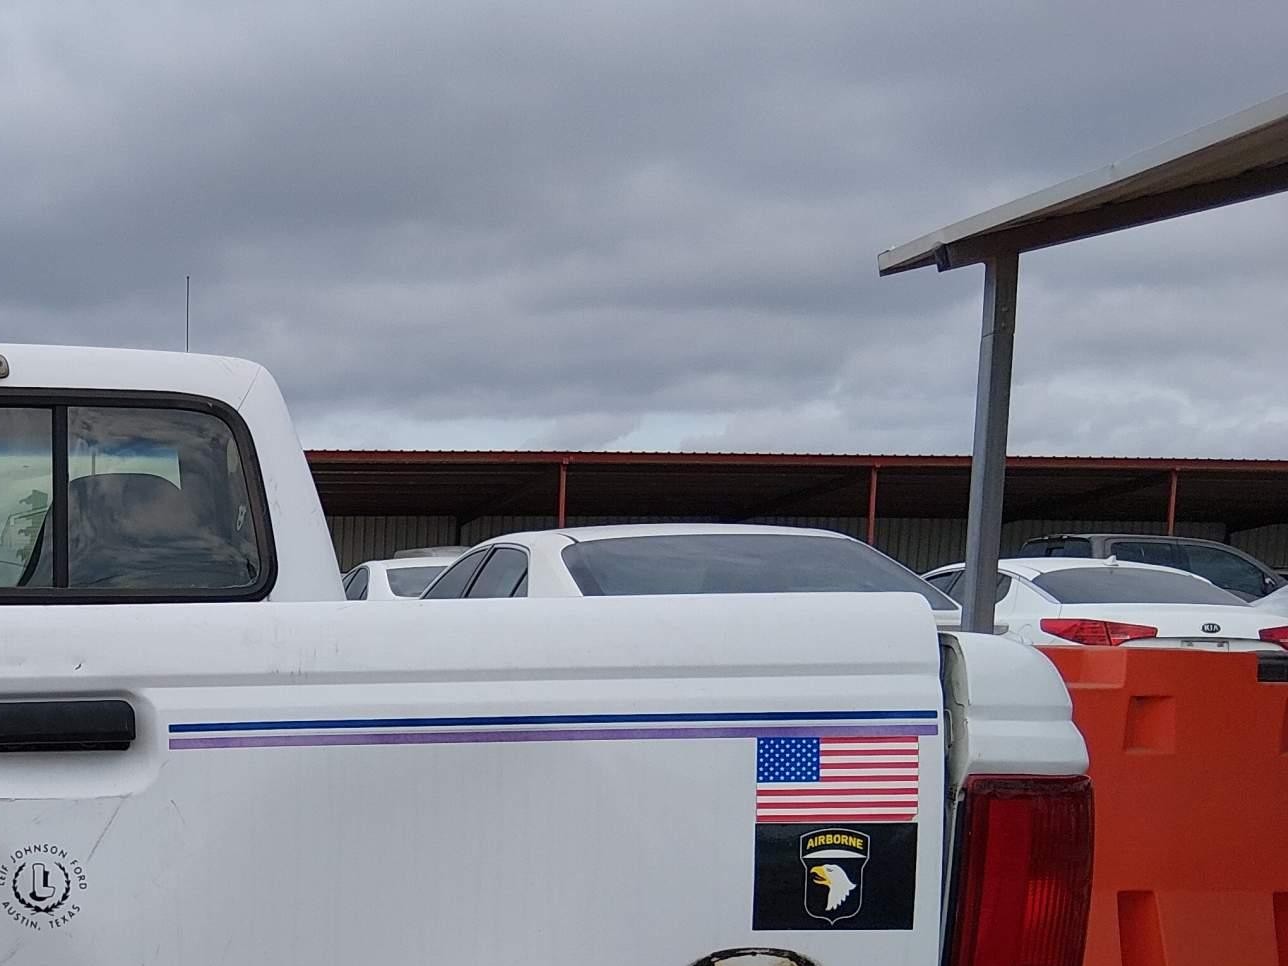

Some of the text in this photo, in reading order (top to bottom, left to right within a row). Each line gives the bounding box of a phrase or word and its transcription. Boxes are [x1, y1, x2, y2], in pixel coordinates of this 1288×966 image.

[806, 834, 864, 850] AIRBORNE
[10, 843, 68, 864] JOHNSON
[70, 859, 88, 890] FORD
[2, 901, 81, 931] AUSTIN, TEXAS
